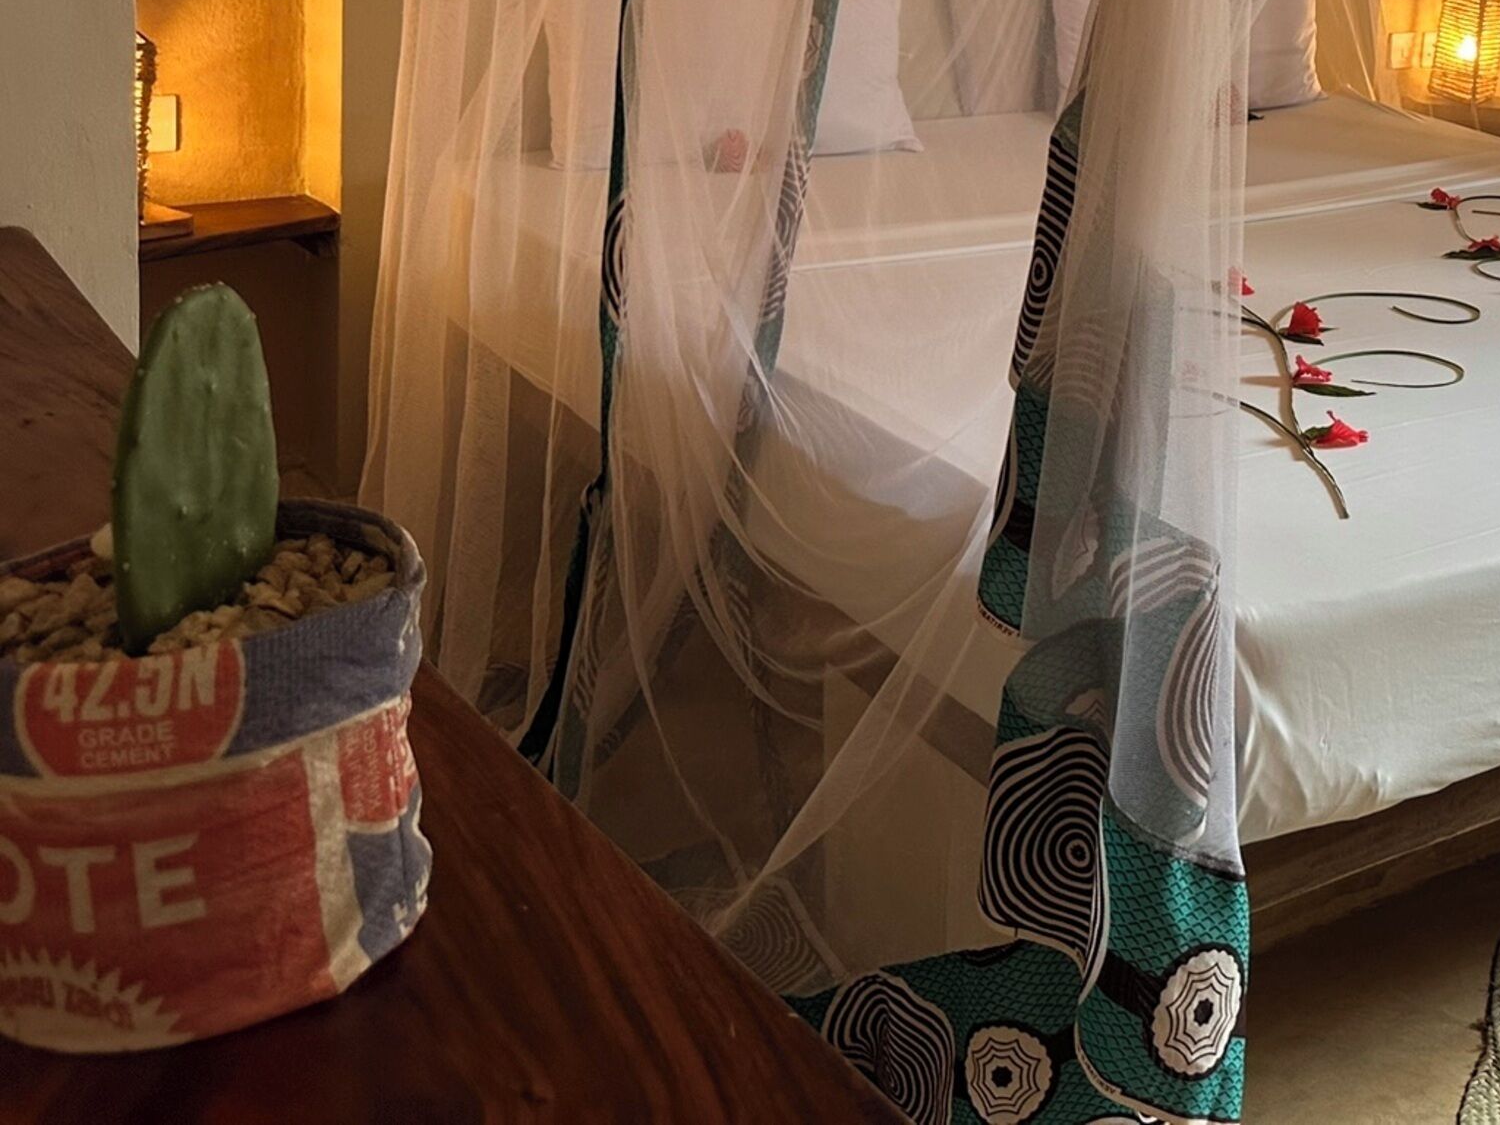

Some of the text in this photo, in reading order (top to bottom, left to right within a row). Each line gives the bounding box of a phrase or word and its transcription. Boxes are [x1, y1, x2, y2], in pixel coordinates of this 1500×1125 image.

[43, 646, 220, 724] 42.5N
[79, 720, 175, 748] GRADE
[81, 742, 177, 769] CEMENT
